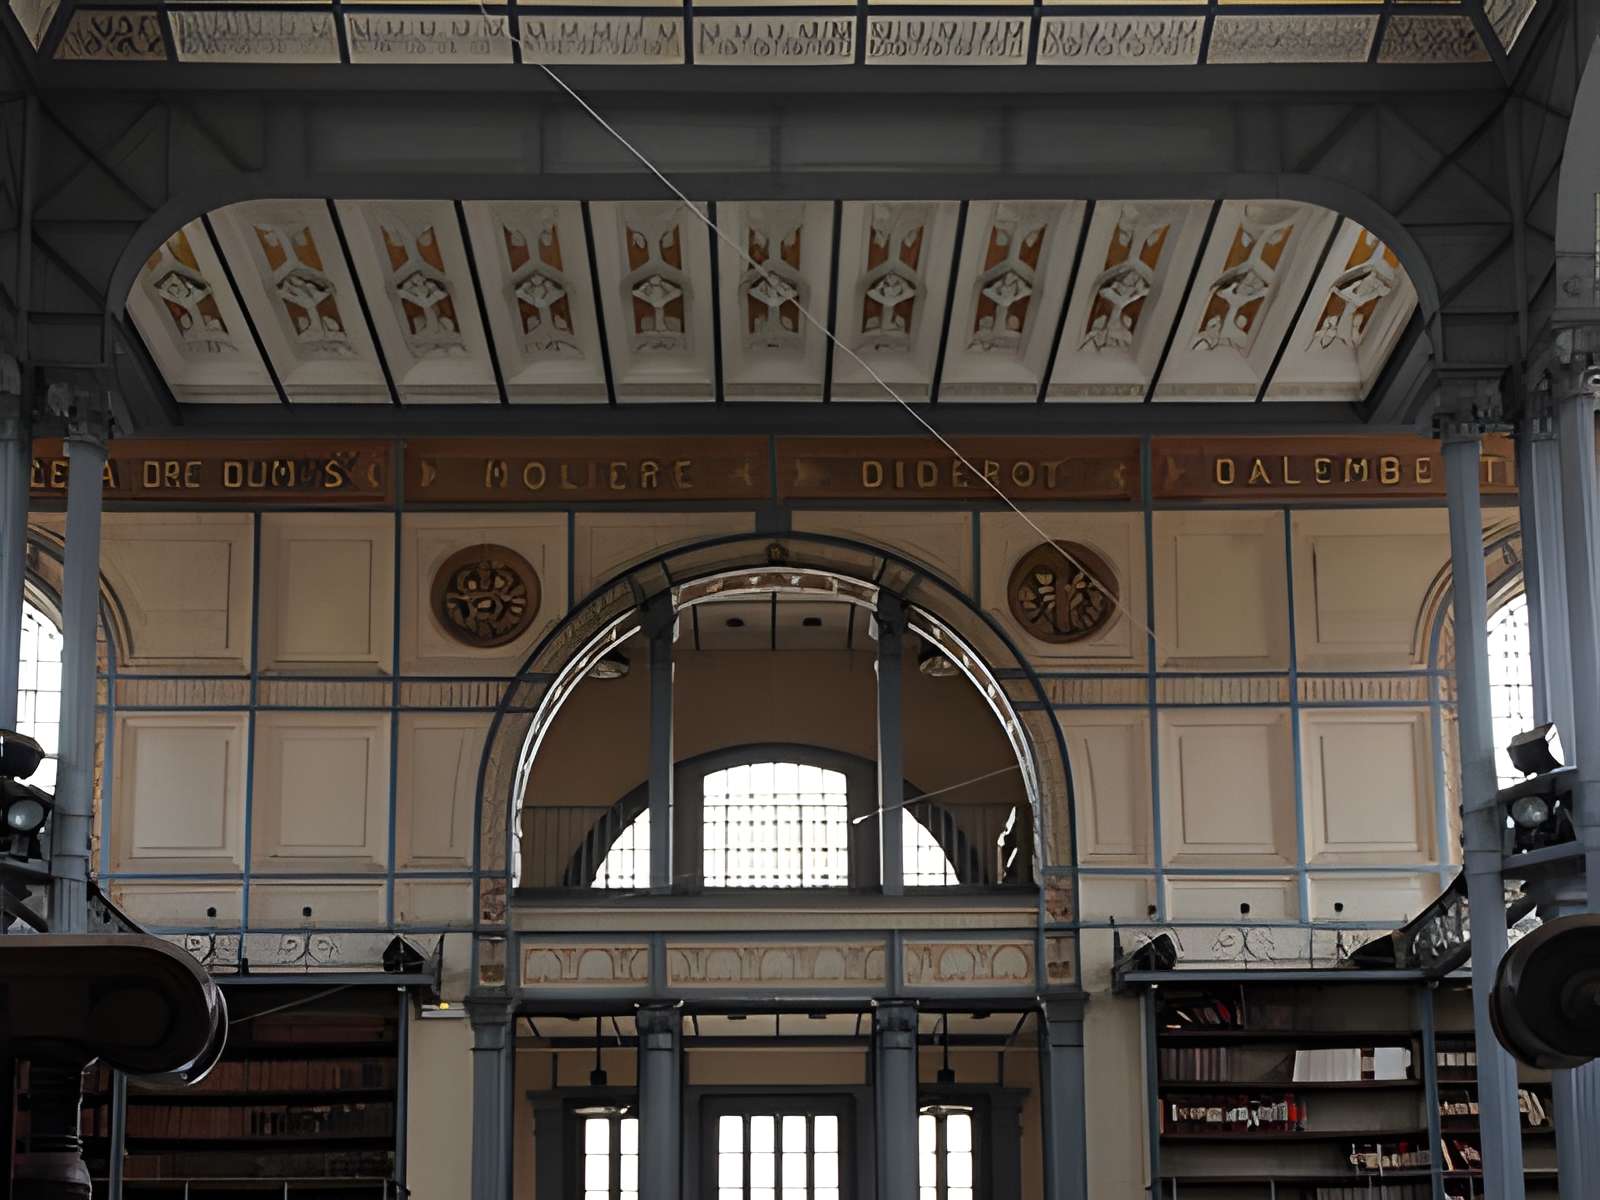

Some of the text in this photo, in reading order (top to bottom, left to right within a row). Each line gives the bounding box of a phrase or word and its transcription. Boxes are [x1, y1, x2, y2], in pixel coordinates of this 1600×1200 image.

[223, 460, 344, 489] DUMS
[485, 461, 693, 490] MOLIERE
[861, 460, 1058, 488] DIDEROT
[1216, 456, 1505, 485] DALEMBET
